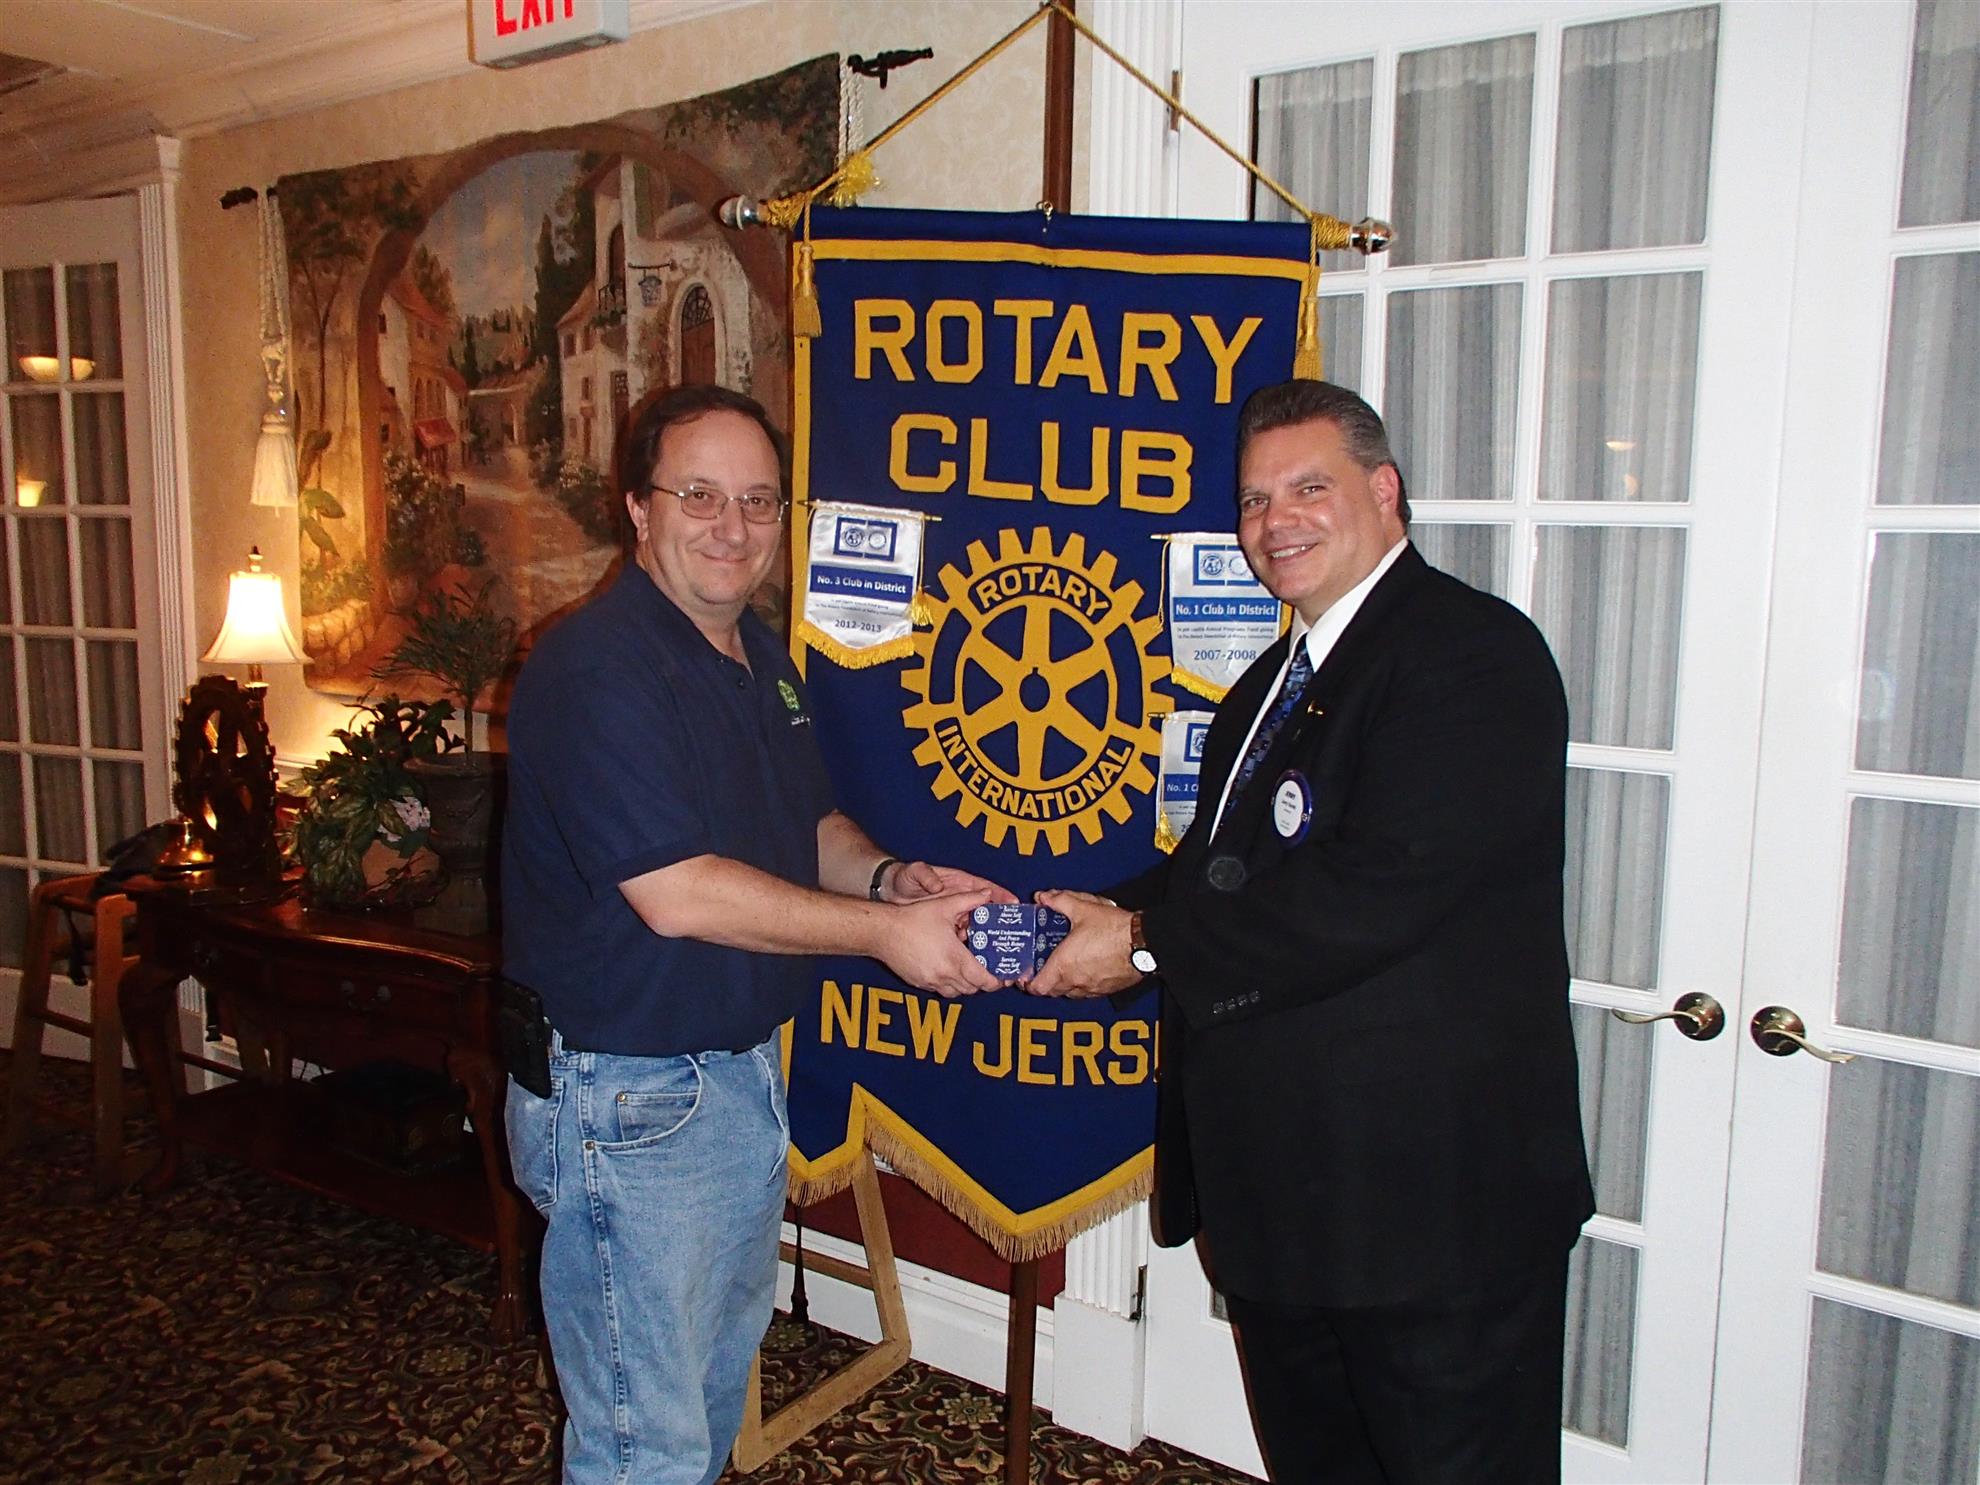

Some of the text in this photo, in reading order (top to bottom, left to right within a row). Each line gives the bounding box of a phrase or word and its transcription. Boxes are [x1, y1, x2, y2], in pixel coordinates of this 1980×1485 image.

[854, 299, 1263, 404] ROTARY
[889, 413, 1193, 514] CLUB
[817, 575, 832, 584] No.
[843, 577, 862, 588] Club
[864, 580, 872, 589] in
[874, 581, 906, 594] District
[975, 566, 1109, 617] ROTARY
[835, 619, 882, 633] 2012-2013
[1176, 604, 1275, 615] No. 1 Club in District
[1194, 649, 1257, 661] 2007-2008
[938, 725, 1131, 819] INTERNATIONAL
[1167, 784, 1181, 792] No.
[820, 980, 1158, 1086] NEW JERS
